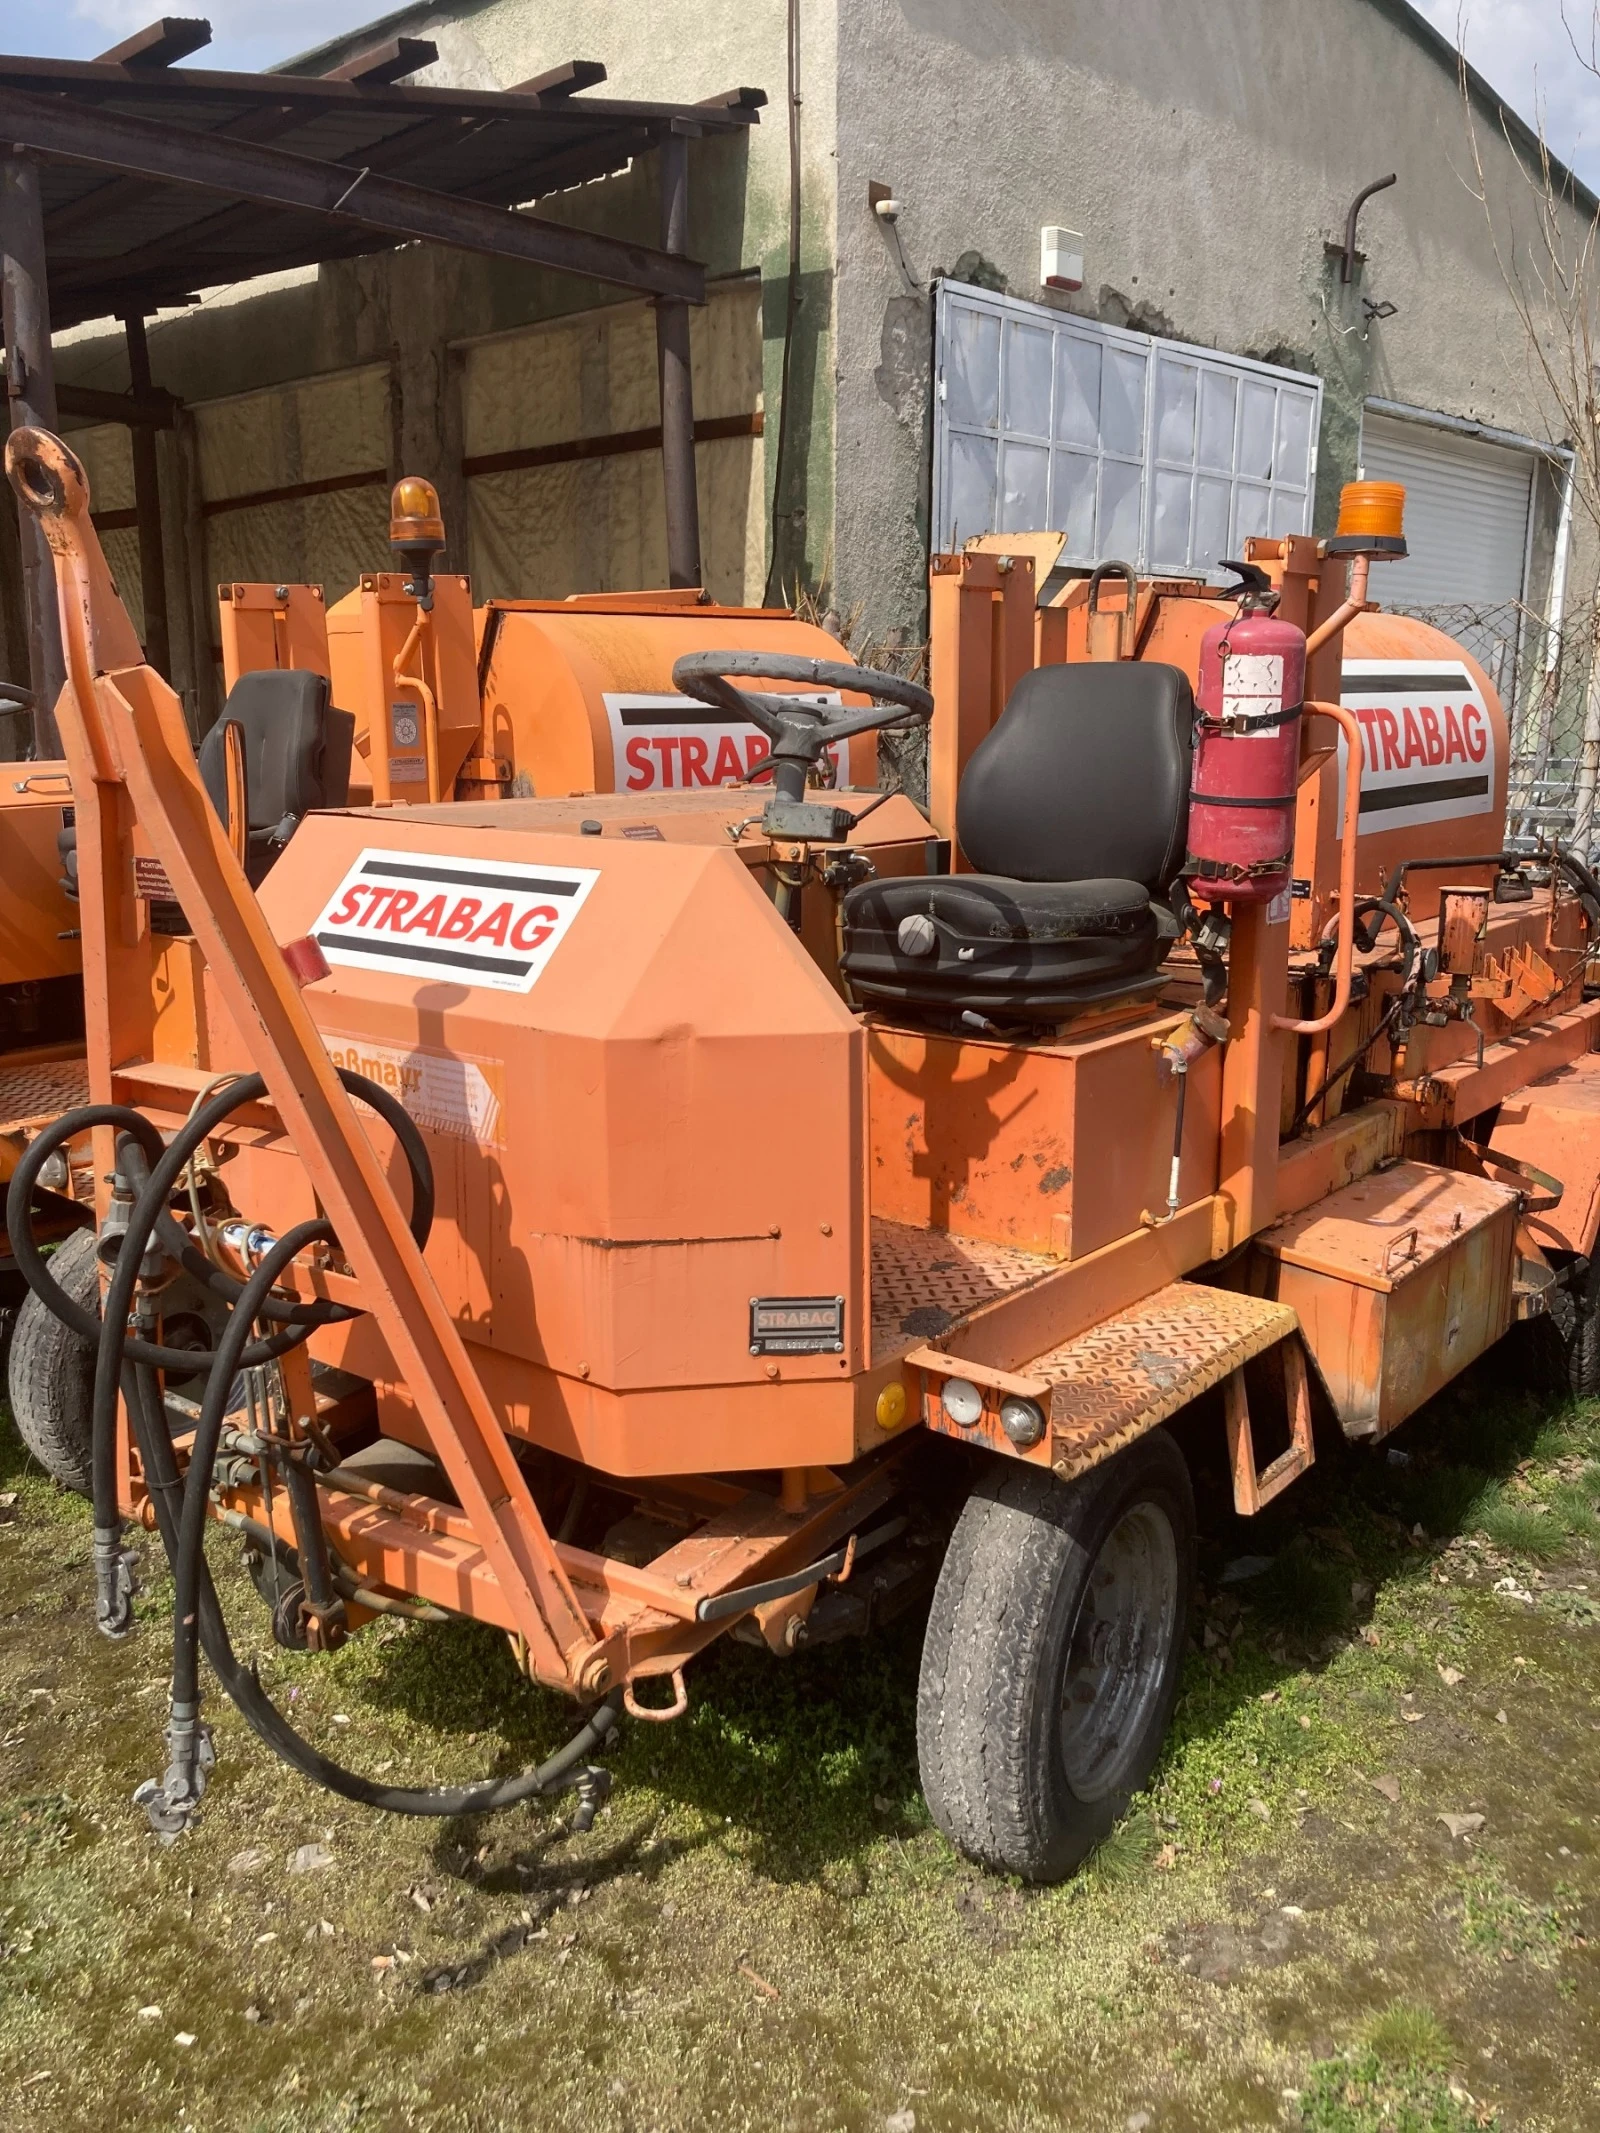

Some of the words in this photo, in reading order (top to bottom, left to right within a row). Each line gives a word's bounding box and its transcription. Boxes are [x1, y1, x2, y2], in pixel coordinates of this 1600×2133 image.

[626, 735, 840, 790] STRAB
[328, 884, 559, 951] STRABAG
[332, 1048, 423, 1097] aßmayr
[758, 1311, 836, 1326] STRABAG
